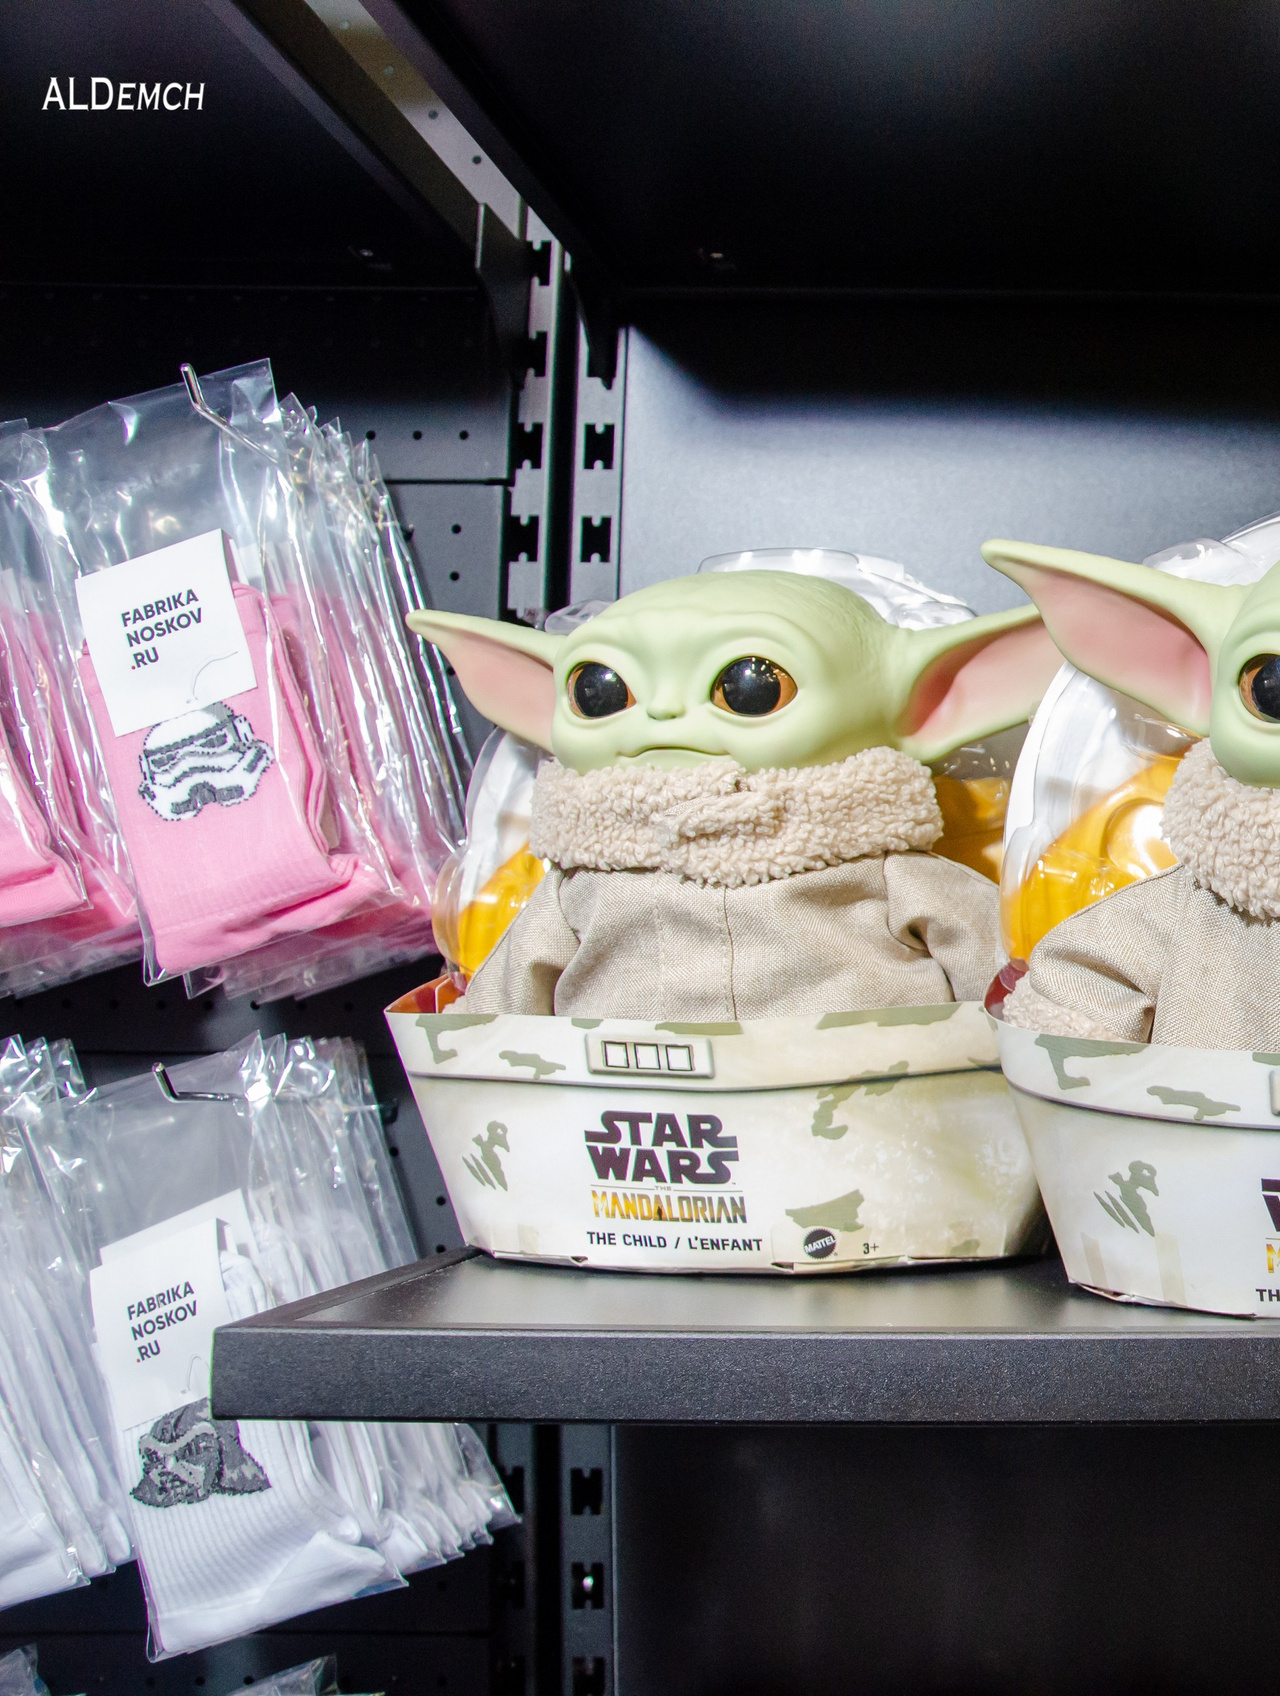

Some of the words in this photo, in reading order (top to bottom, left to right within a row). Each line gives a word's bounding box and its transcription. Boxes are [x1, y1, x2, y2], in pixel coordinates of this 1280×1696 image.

[121, 588, 199, 628] FABRIKA
[126, 607, 202, 648] NOSKOV
[131, 646, 160, 670] .RU
[584, 1110, 738, 1148] STAR
[586, 1145, 739, 1184] WARS
[591, 1190, 748, 1224] MANDALORIAN
[586, 1231, 617, 1246] THE
[623, 1233, 668, 1249] CHILD
[688, 1236, 763, 1252] L'ENFANT
[804, 1235, 836, 1253] MATTEL
[863, 1242, 879, 1255] 3+
[127, 1281, 195, 1321] FABRIKA
[131, 1300, 197, 1341] NOSKOV
[136, 1339, 161, 1363] .RU
